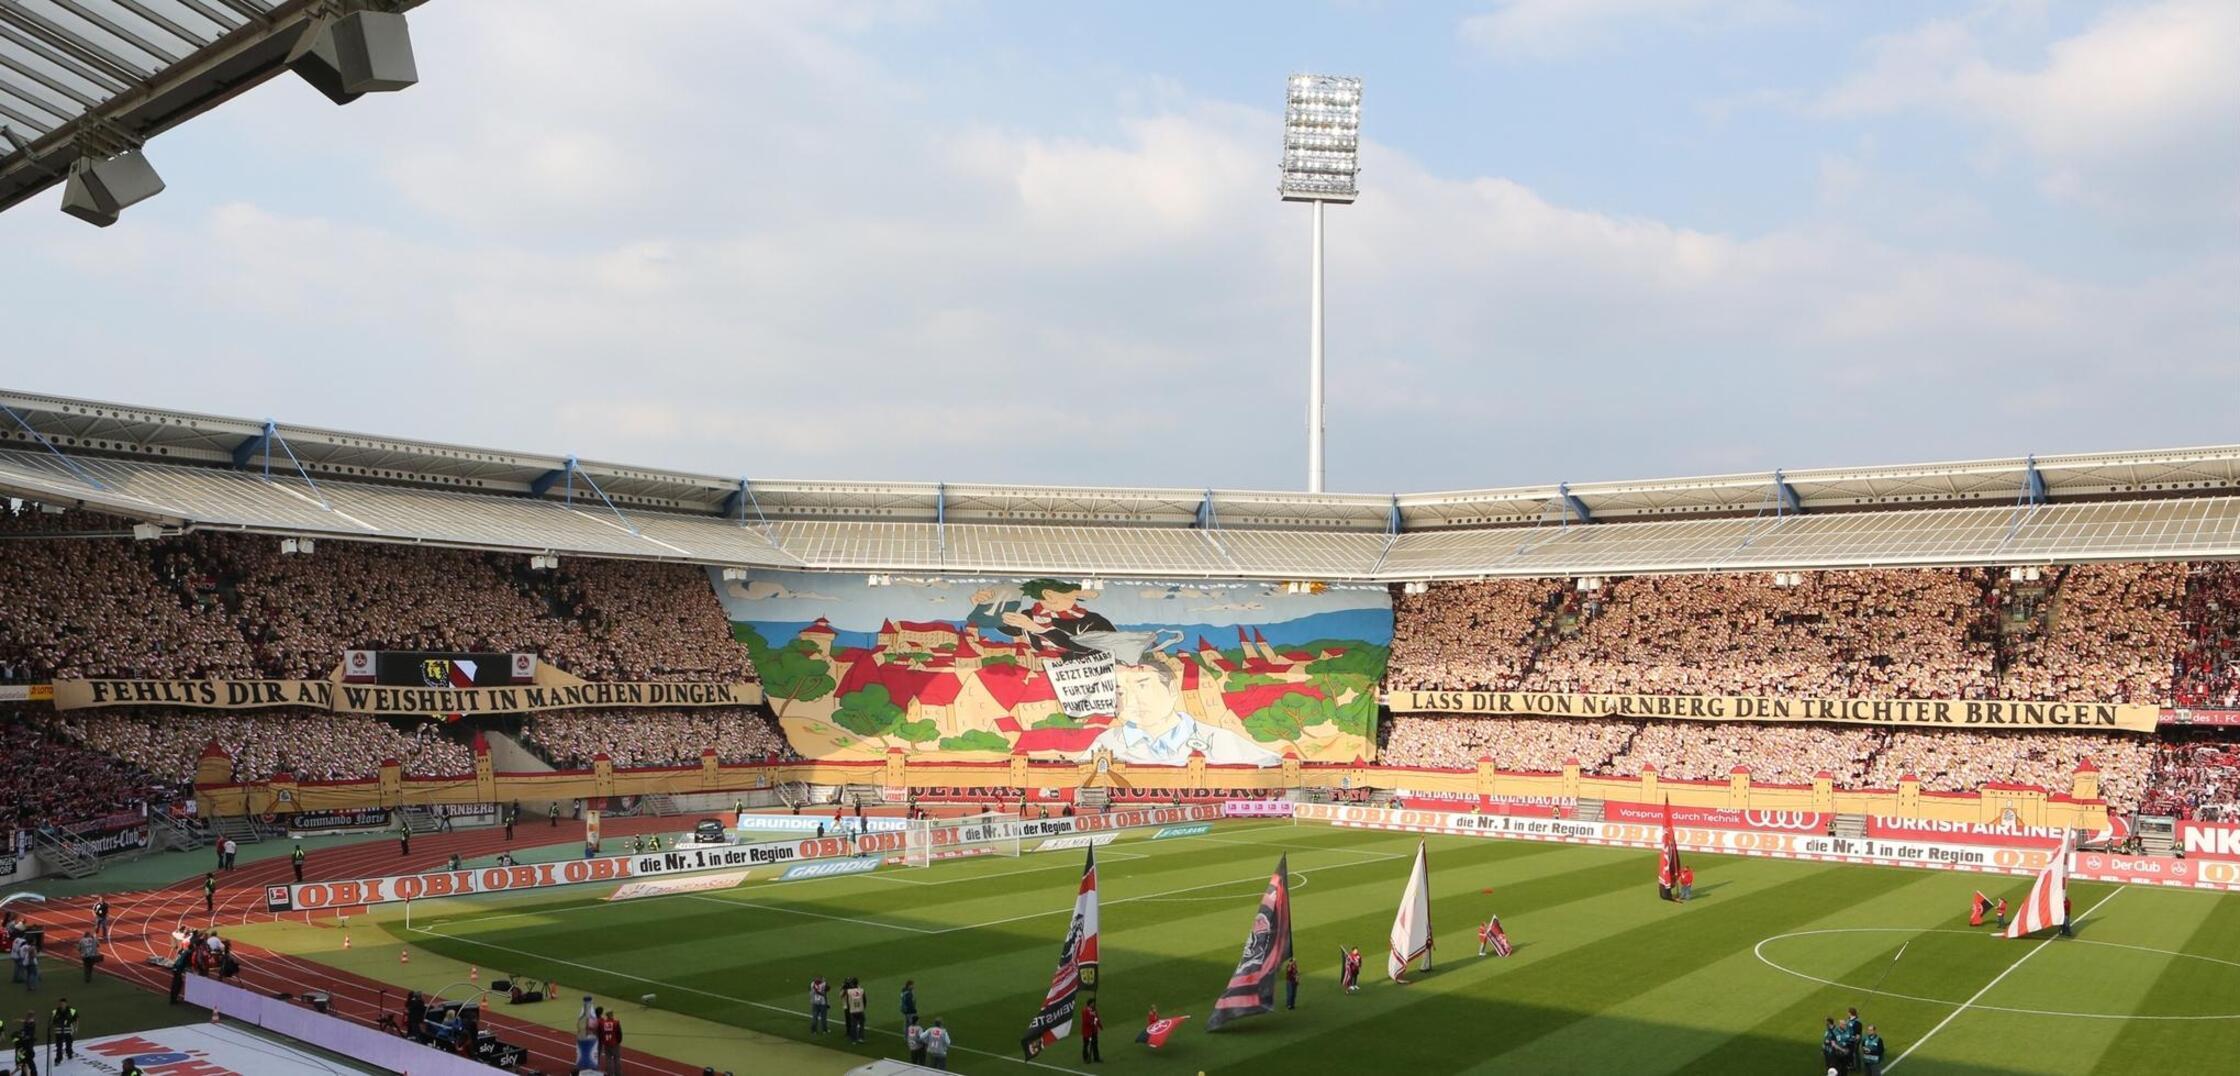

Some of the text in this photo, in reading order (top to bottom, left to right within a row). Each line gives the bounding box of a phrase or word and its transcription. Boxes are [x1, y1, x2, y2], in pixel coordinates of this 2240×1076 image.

[1056, 668, 1081, 681] JETZT
[89, 681, 738, 711] FEHLTS DIR AN WEISHEIT IN MANCHEN DINGEN,
[1412, 693, 1463, 710] LASS
[1472, 694, 1514, 711] DIR
[1523, 694, 1571, 714] VON
[1735, 699, 1790, 718] DEN
[1801, 700, 1953, 723] TRICHTER
[1965, 702, 2117, 725] BRINGEN
[2225, 713, 2238, 722] FC
[294, 814, 352, 828] Commando
[743, 818, 820, 829] GRUNDIG
[1075, 815, 1112, 832] OBI
[1116, 811, 1149, 828] OBI
[1154, 808, 1187, 824] OBI
[1192, 804, 1223, 821] OBI
[1295, 804, 1341, 820] OBI
[1346, 806, 1393, 822] OBI
[1401, 810, 1449, 826] OBI
[1456, 816, 1473, 828] die
[1477, 816, 1498, 830] Nr.
[1502, 817, 1510, 830] 1
[1514, 819, 1525, 831] in
[1527, 820, 1548, 833] der
[1551, 822, 1594, 838] Region
[1672, 811, 1701, 821] durch
[1703, 813, 1740, 824] Technik
[859, 832, 907, 852] OBI
[965, 827, 980, 840] die
[982, 824, 1001, 839] Nr.
[1003, 824, 1010, 836] 1
[1024, 822, 1039, 835] der
[1041, 820, 1072, 838] Region
[1602, 824, 1663, 842] OBI
[1734, 832, 1797, 851] OBI
[1806, 840, 1828, 853] die
[1833, 839, 1859, 855] Nr.
[1866, 841, 1875, 855] 1
[1880, 843, 1893, 857] in
[1897, 844, 1924, 859] der
[1928, 847, 1984, 864] Region
[789, 858, 881, 879] GRUNDIG
[2111, 858, 2161, 873] Der Club
[298, 845, 794, 907] OBI OBI OBI OBI die Nr. 1 in der Region
[480, 1043, 495, 1053] sky
[501, 1053, 518, 1066] sky
